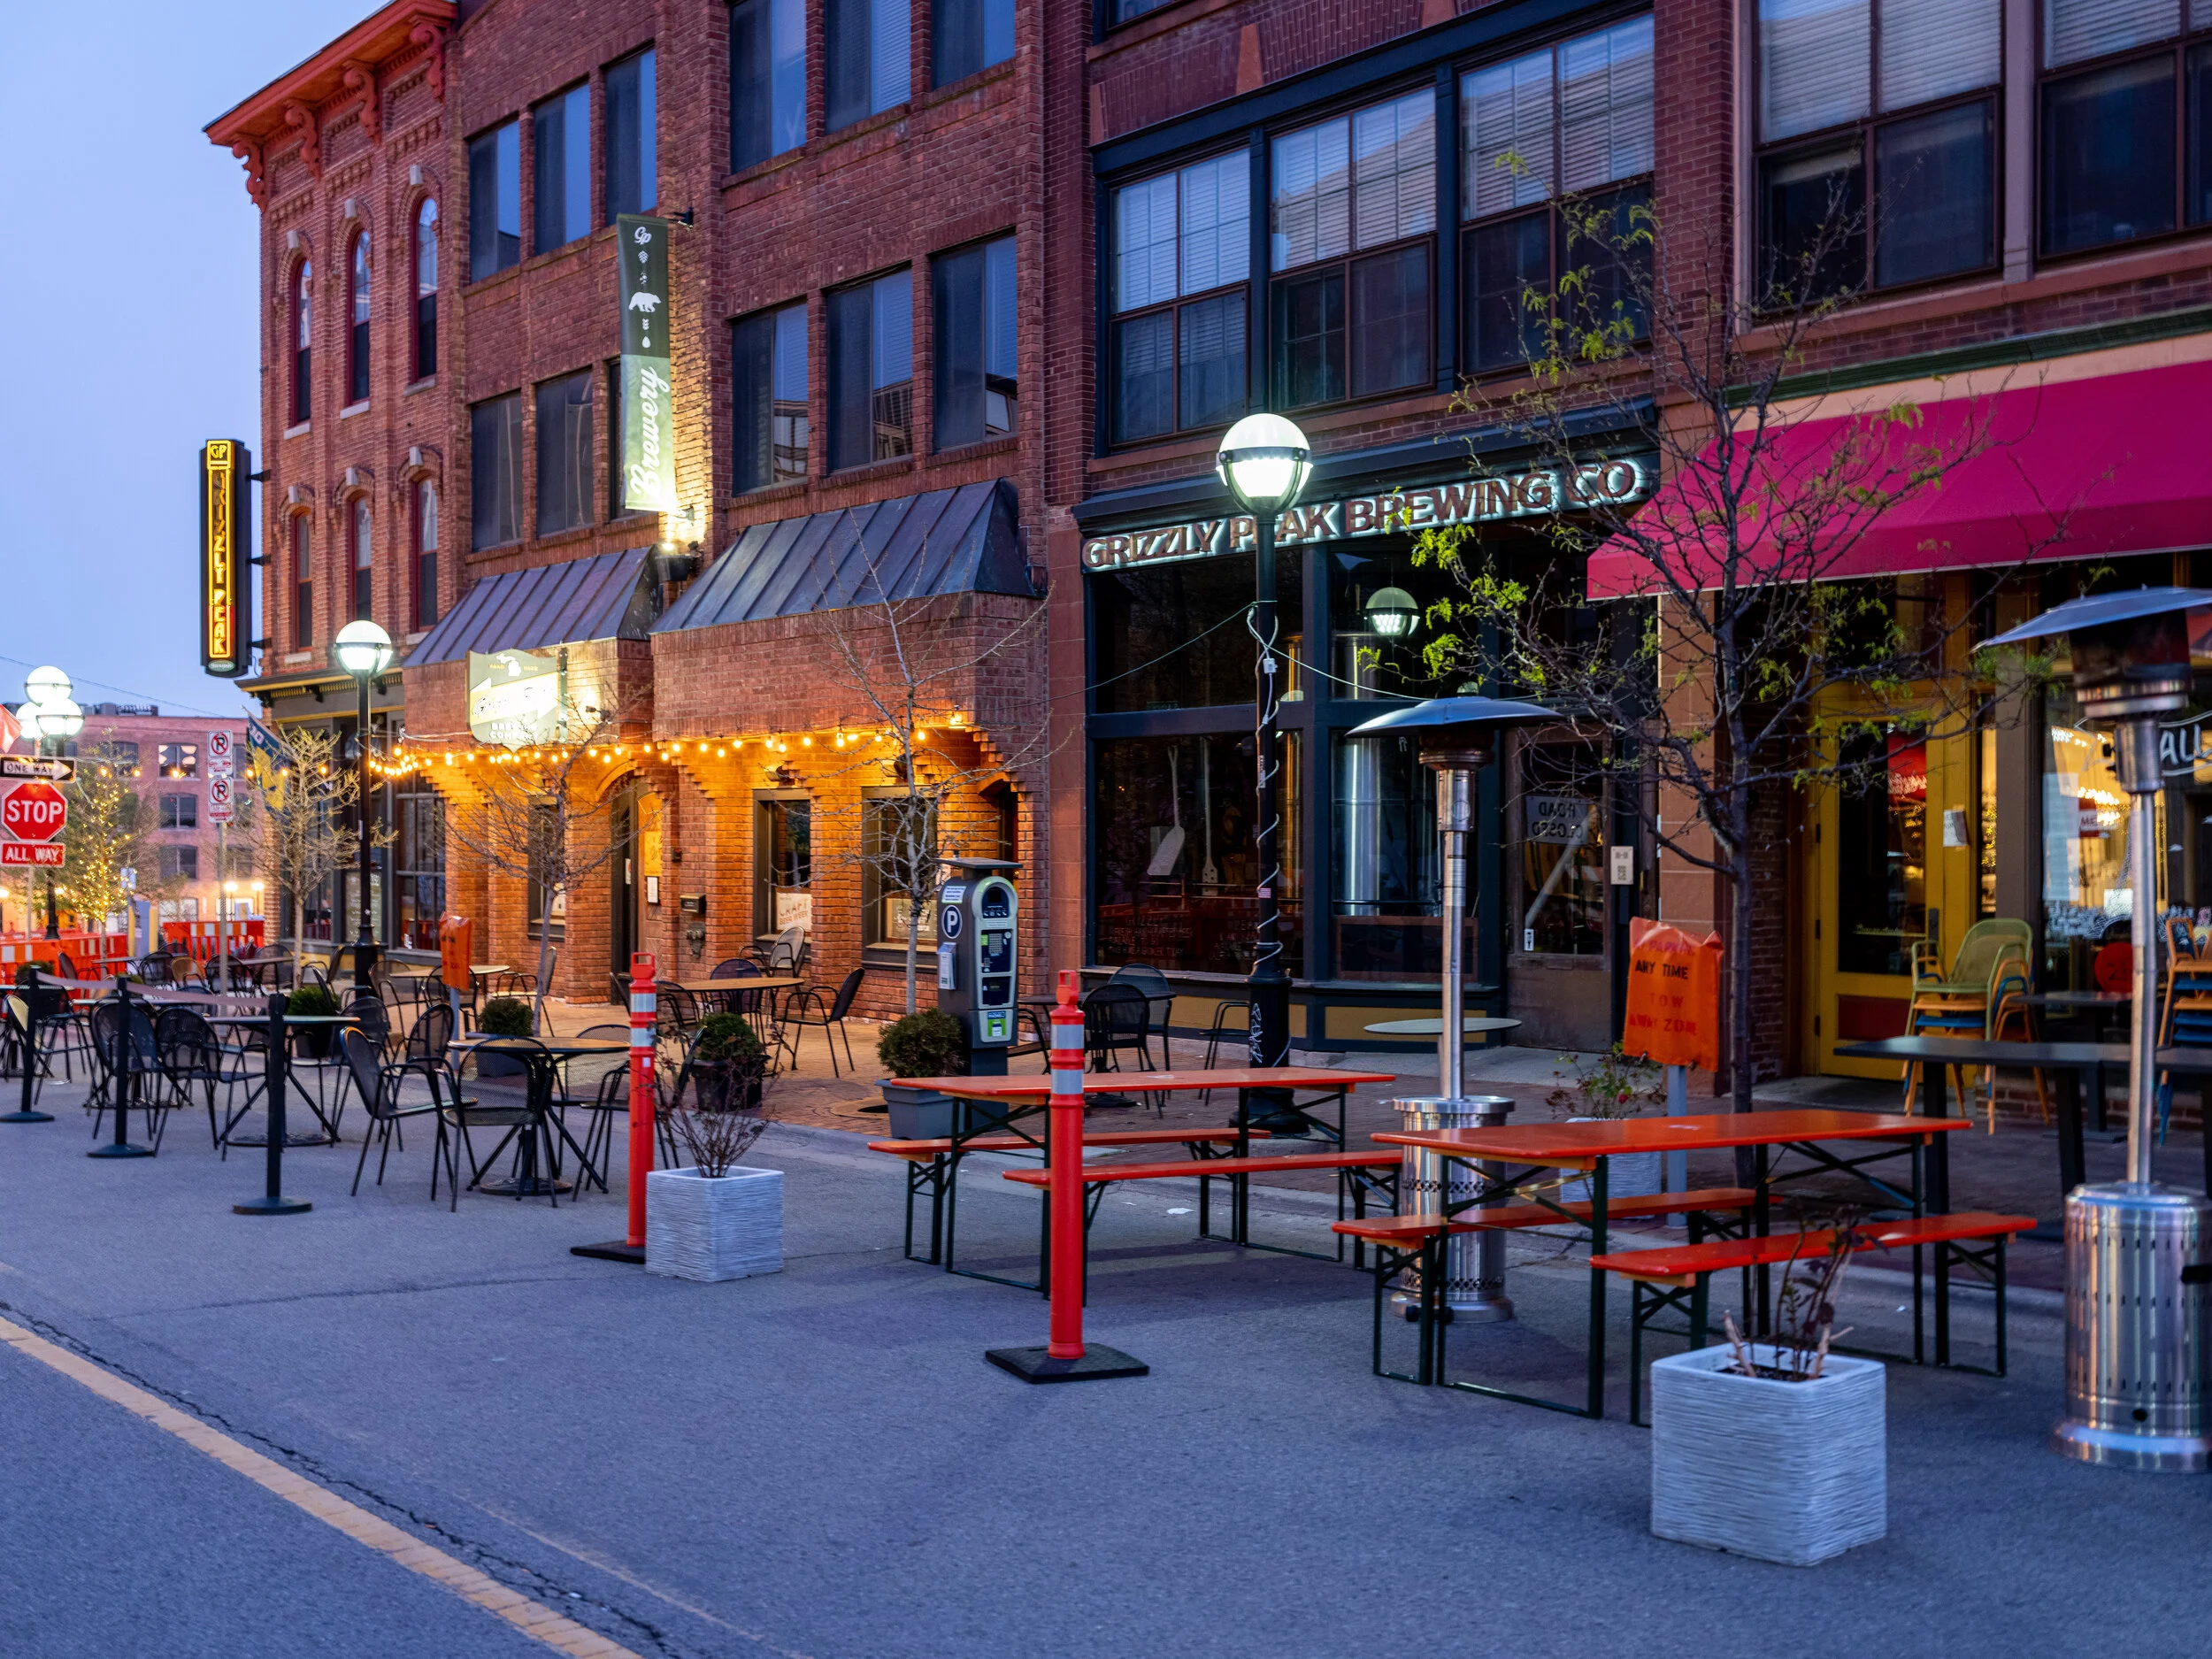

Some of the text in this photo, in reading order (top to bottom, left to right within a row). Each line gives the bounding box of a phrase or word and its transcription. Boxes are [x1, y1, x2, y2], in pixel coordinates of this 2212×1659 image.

[629, 365, 671, 495] Brewery
[1082, 520, 1220, 568] GRIZZLY
[1230, 503, 1339, 549] PAK
[1345, 472, 1551, 533] BREWING
[213, 588, 227, 654] PEAK
[6, 764, 52, 773] ONE WAY
[5, 799, 64, 824] STOP
[5, 846, 59, 862] ALL WAY
[947, 910, 958, 933] P
[1635, 959, 1689, 980] ANY TIME
[1650, 994, 1685, 1010] TOW
